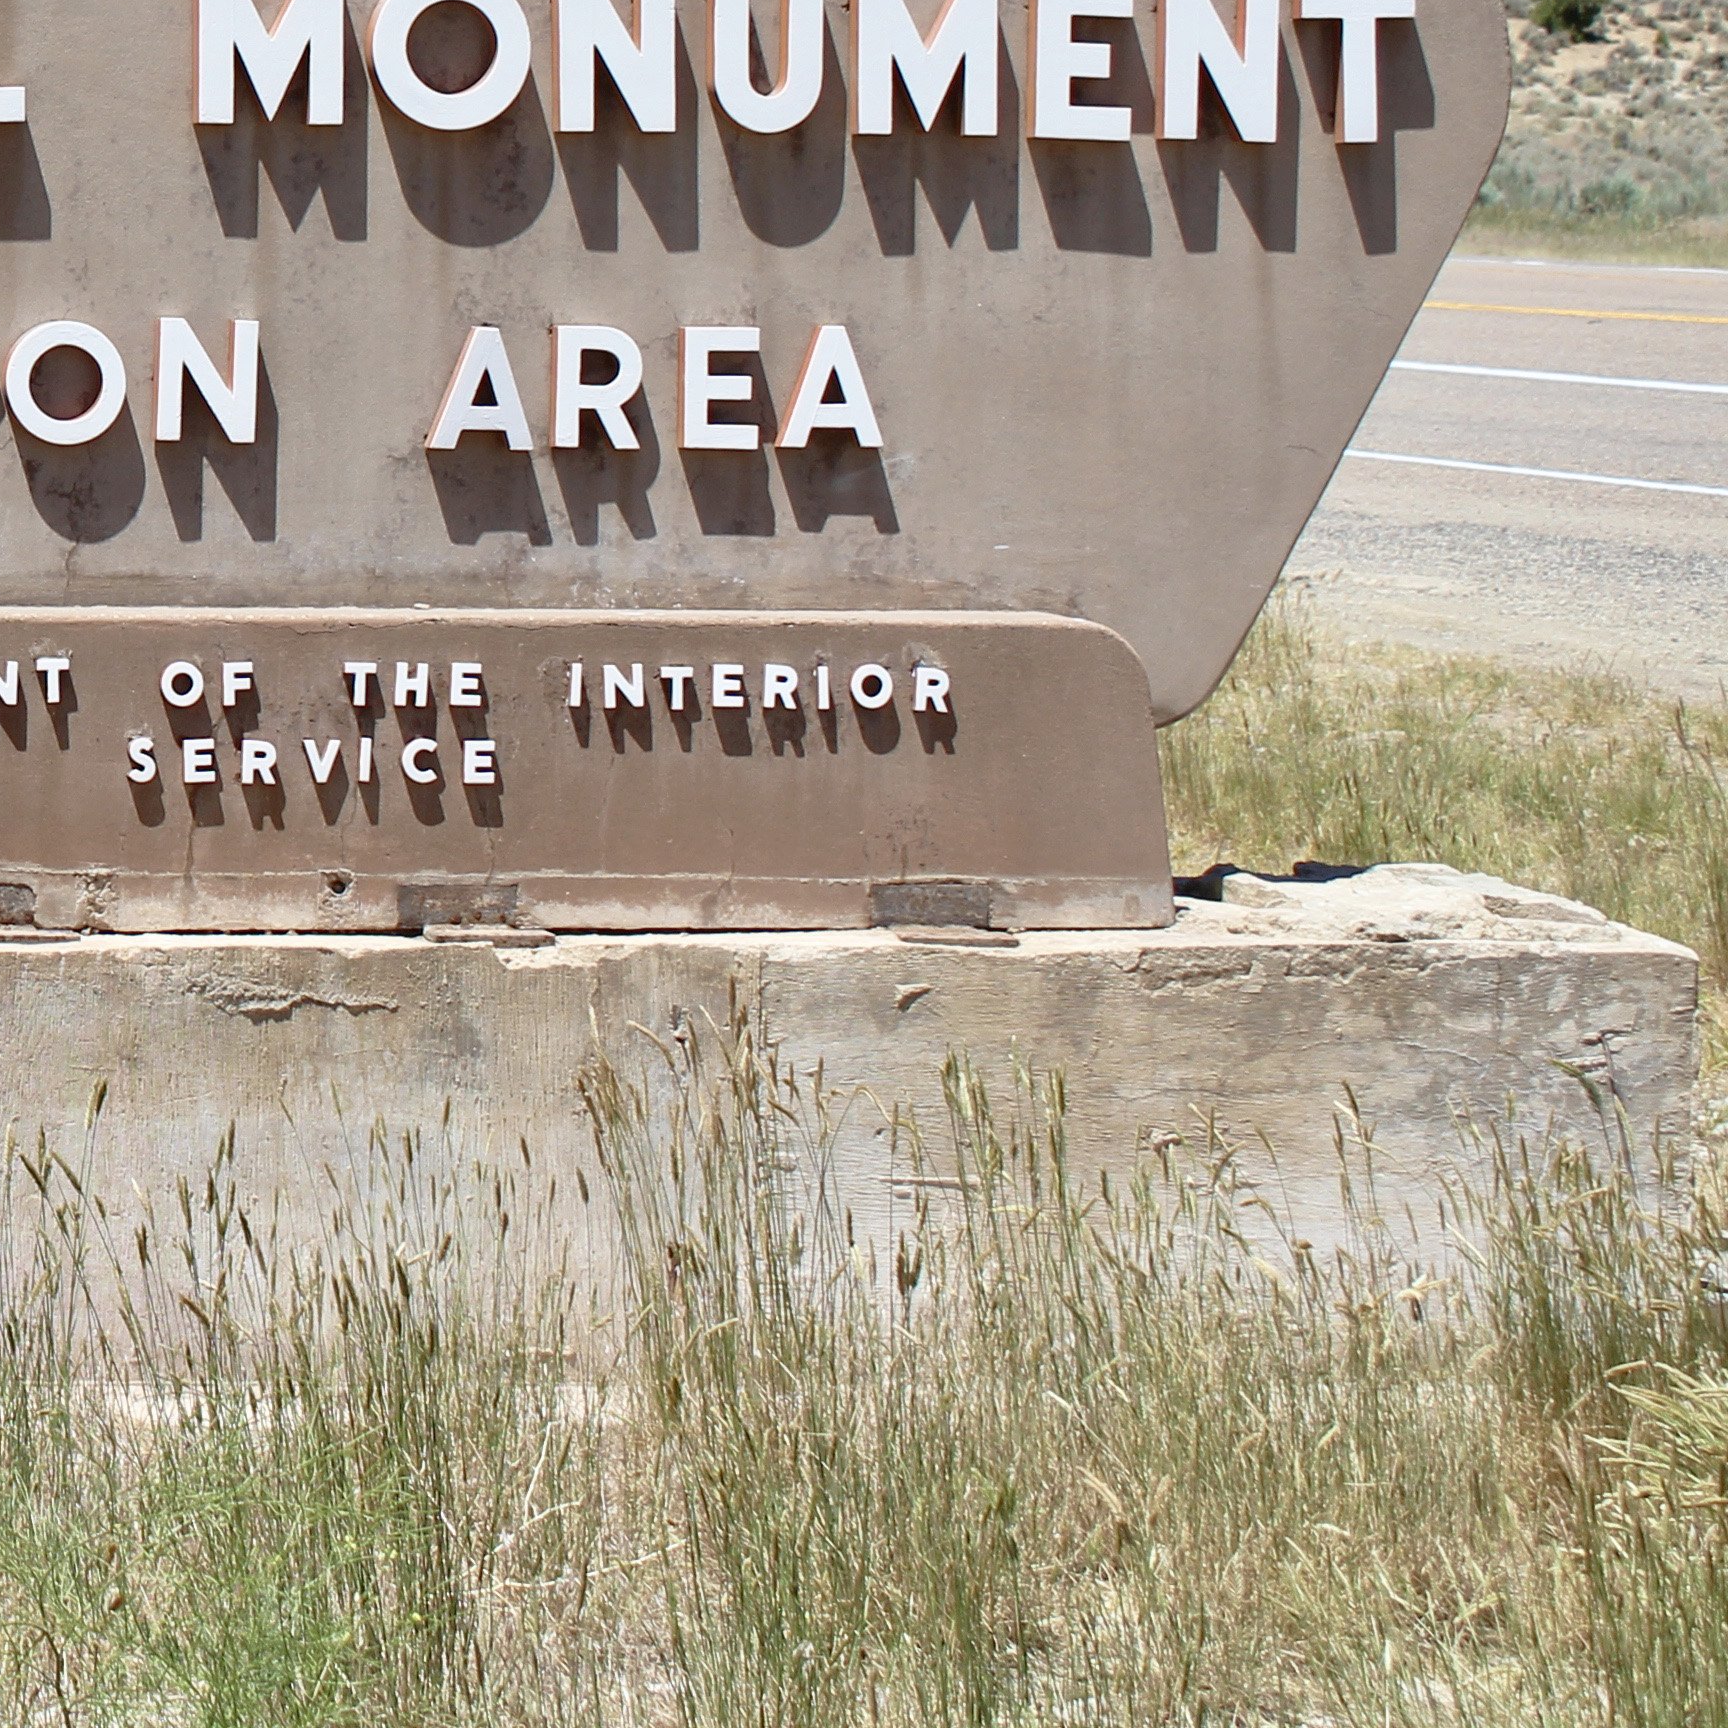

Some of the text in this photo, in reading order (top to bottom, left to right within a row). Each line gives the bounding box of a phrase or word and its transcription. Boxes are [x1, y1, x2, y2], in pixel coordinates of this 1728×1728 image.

[426, 323, 886, 452] AREA
[159, 659, 255, 708] OF
[342, 660, 483, 708] THE
[568, 661, 951, 714] INTERIOR
[125, 734, 497, 785] SERVICE
